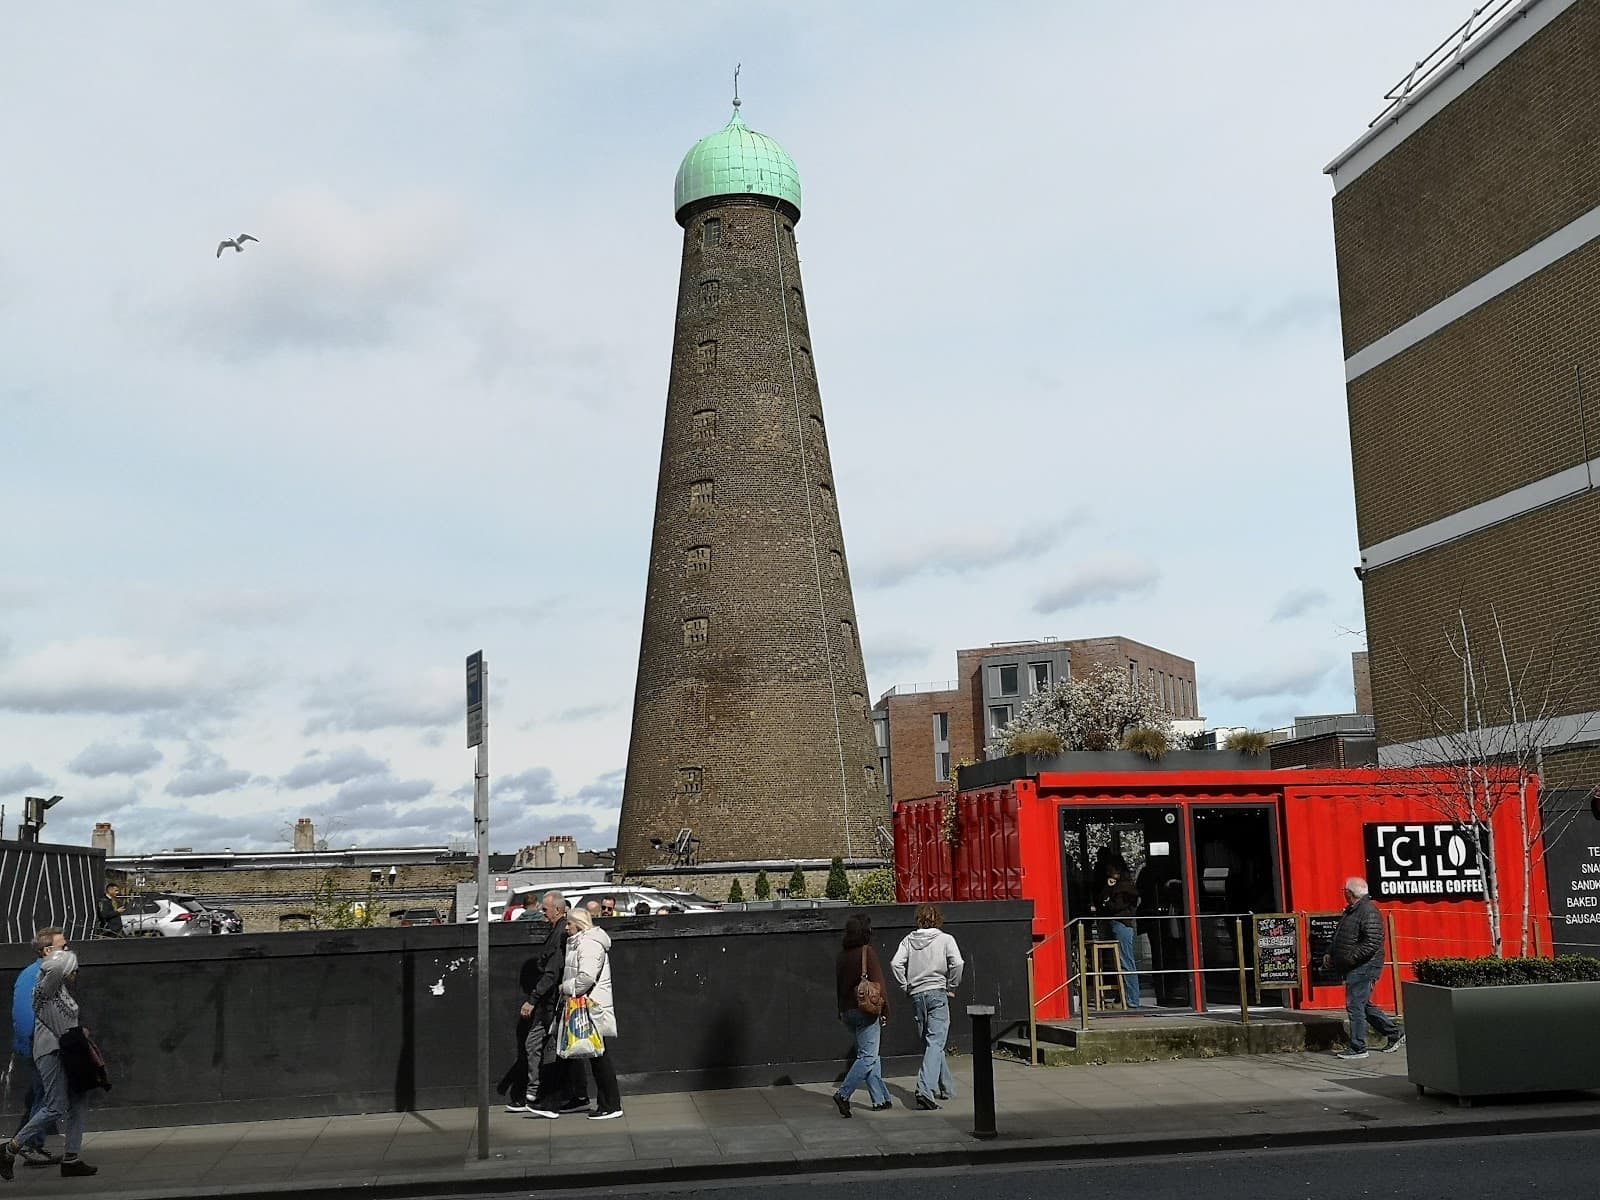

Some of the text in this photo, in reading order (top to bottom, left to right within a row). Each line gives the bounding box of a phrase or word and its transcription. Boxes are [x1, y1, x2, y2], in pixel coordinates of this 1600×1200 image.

[1581, 863, 1600, 874] SNA
[1380, 879, 1484, 895] CONTAINER COFFEE
[1566, 896, 1598, 908] BAKED
